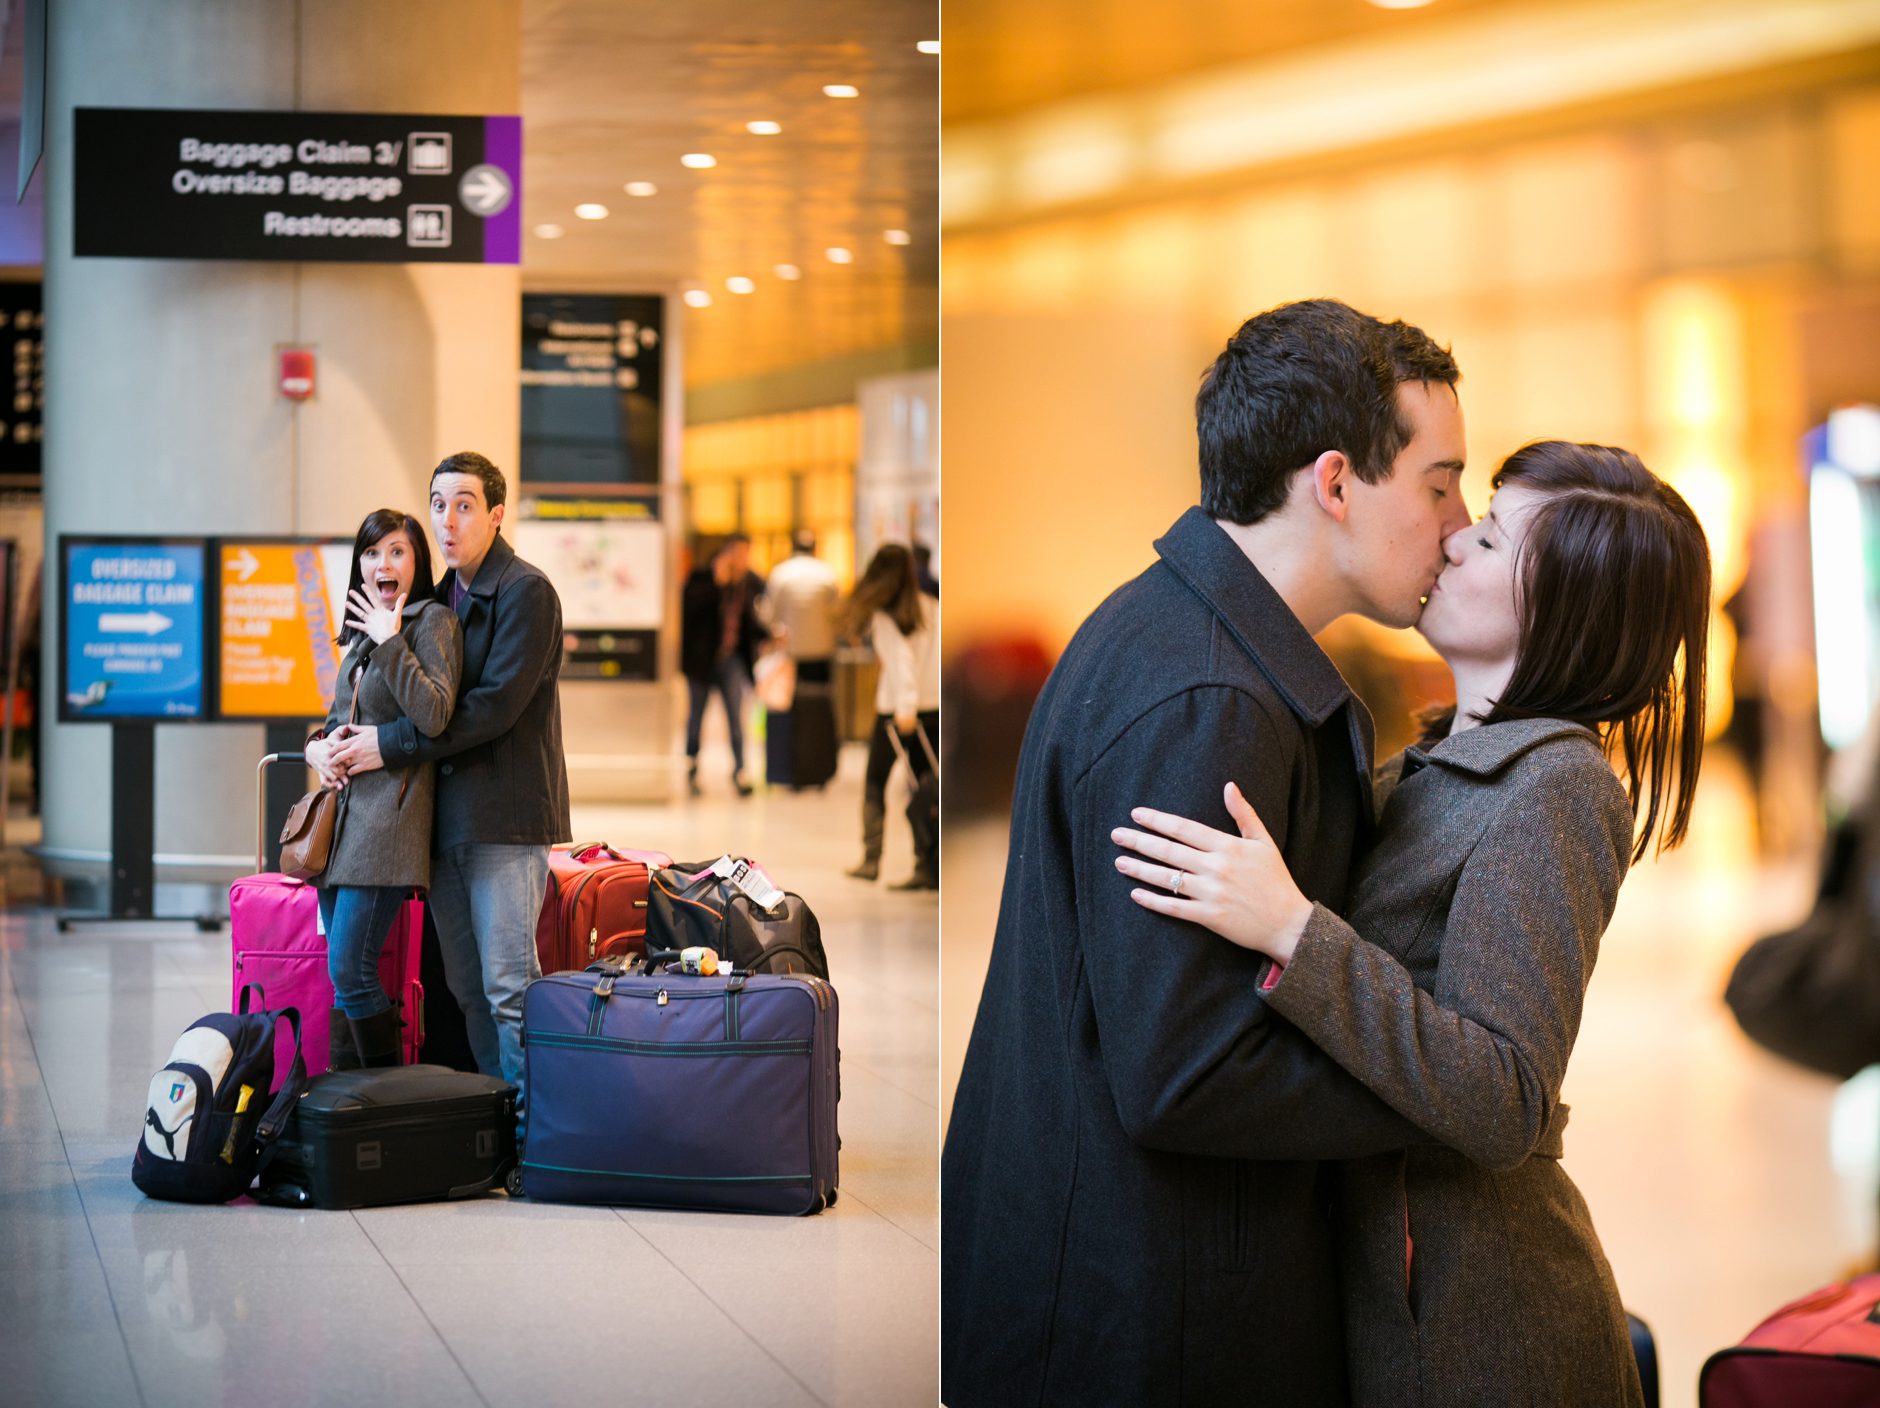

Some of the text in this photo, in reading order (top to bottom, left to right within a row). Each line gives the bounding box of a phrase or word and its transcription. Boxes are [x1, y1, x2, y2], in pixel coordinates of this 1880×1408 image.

[179, 138, 293, 169] Baggage
[297, 139, 371, 164] Claim
[172, 169, 402, 201] Oversize Baggage
[263, 211, 402, 238] Restrooms
[91, 557, 177, 580] OVERSIZED
[73, 582, 194, 605] BAGGAGE CLAIM
